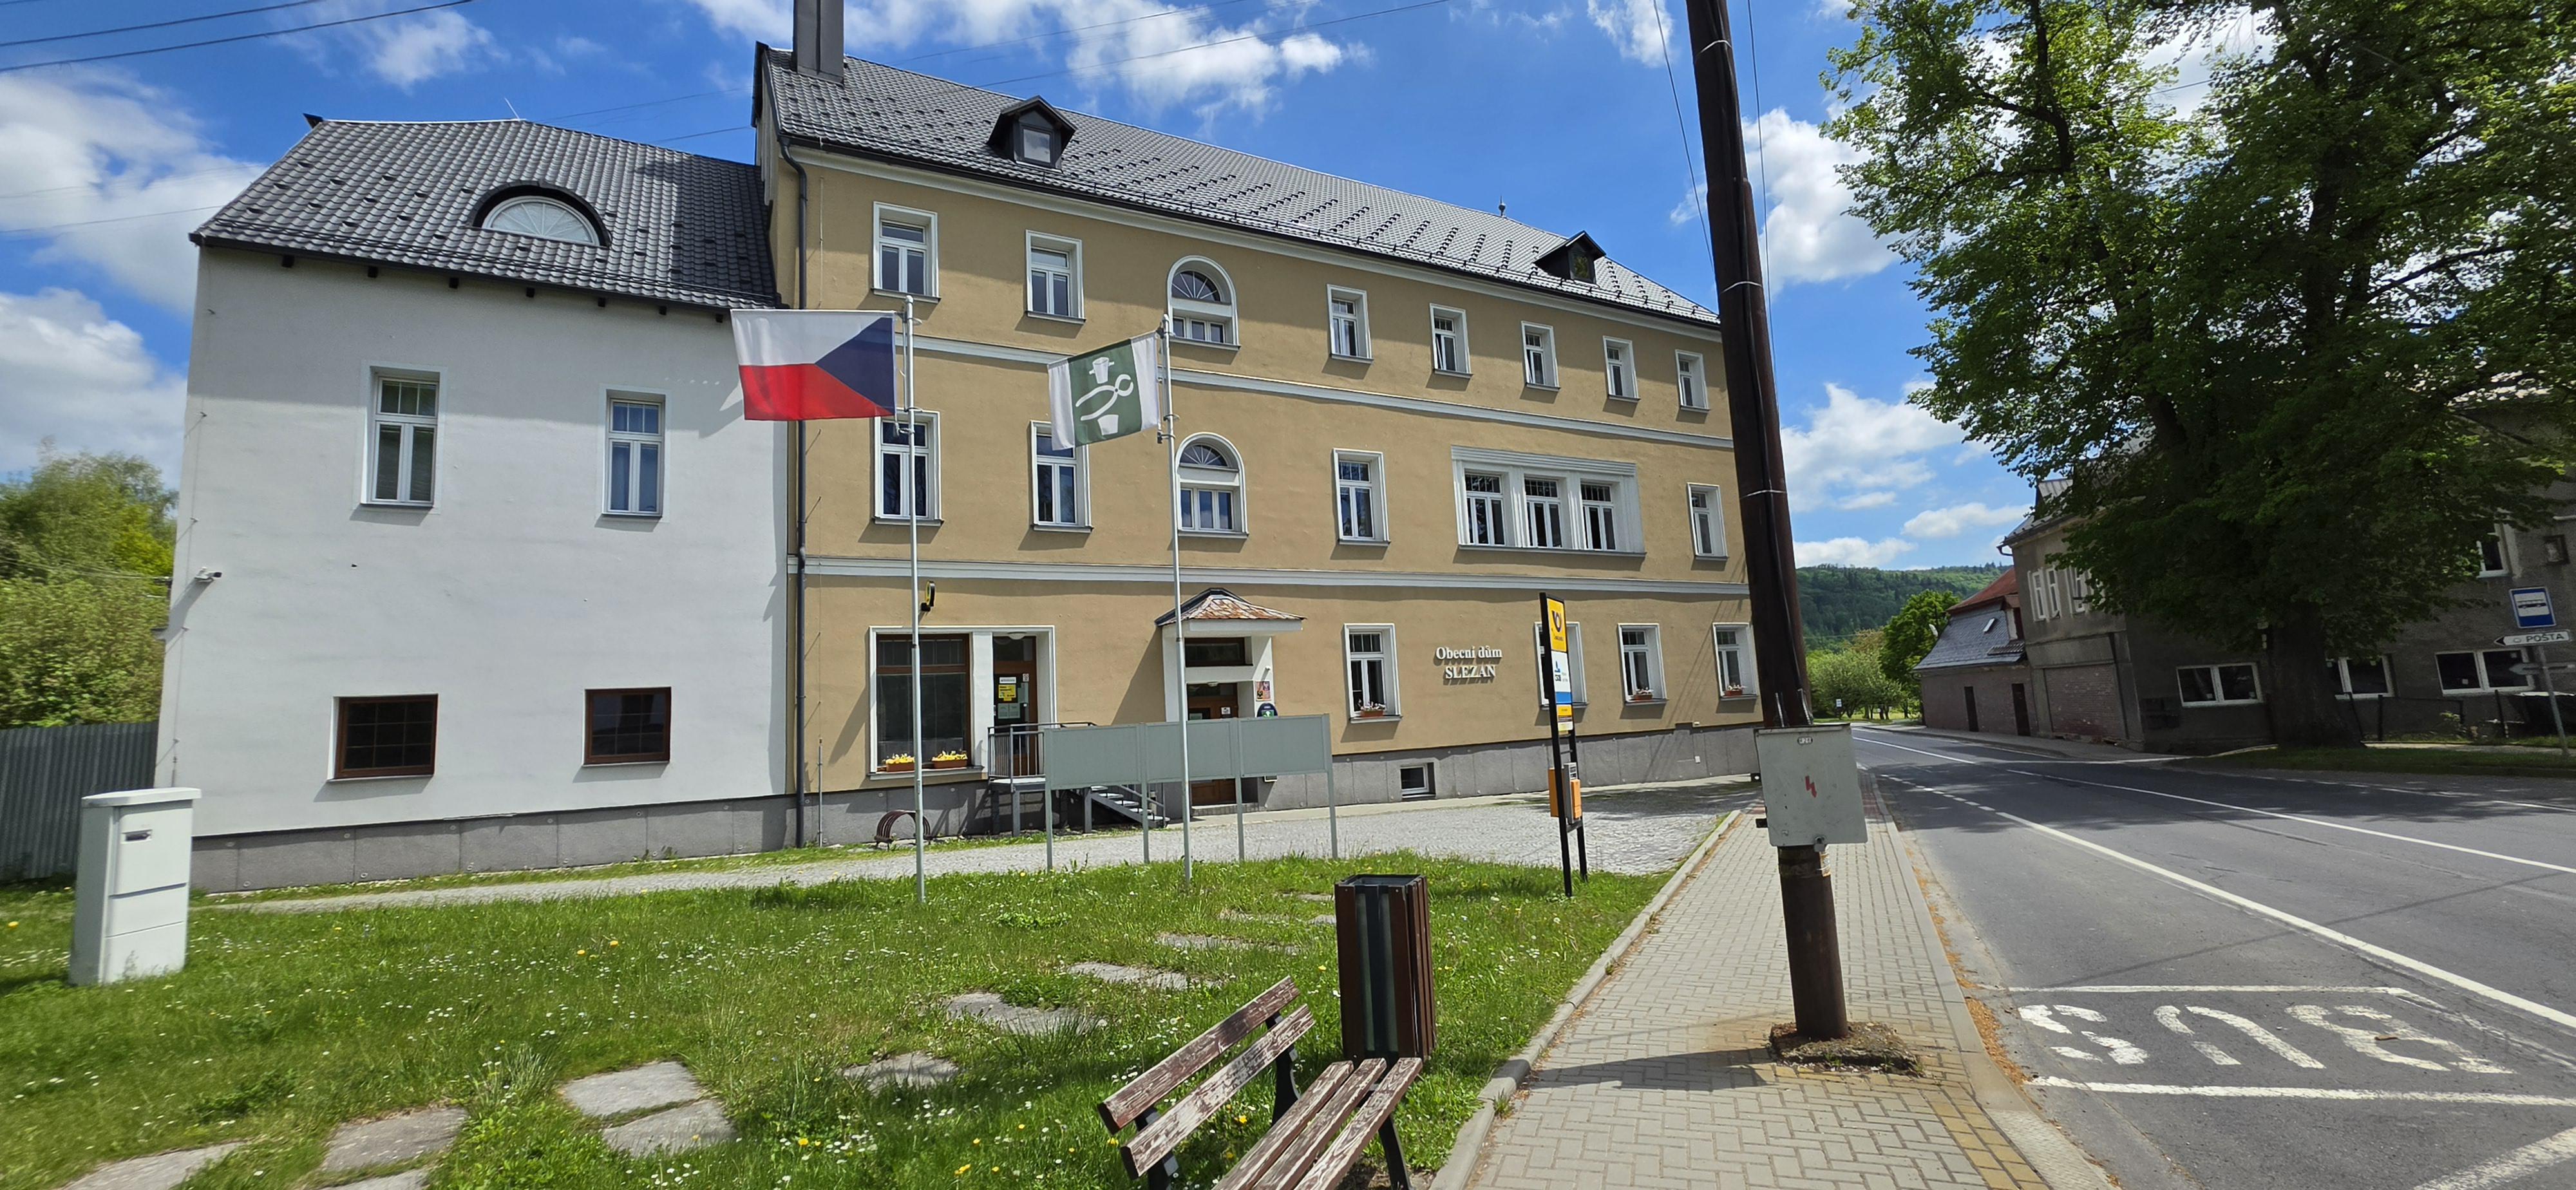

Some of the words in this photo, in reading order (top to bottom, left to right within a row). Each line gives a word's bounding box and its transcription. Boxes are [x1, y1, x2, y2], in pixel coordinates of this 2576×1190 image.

[2525, 633, 2564, 643] POŠTA
[1478, 645, 1502, 658] dům
[2017, 1004, 2517, 1074] BUS
